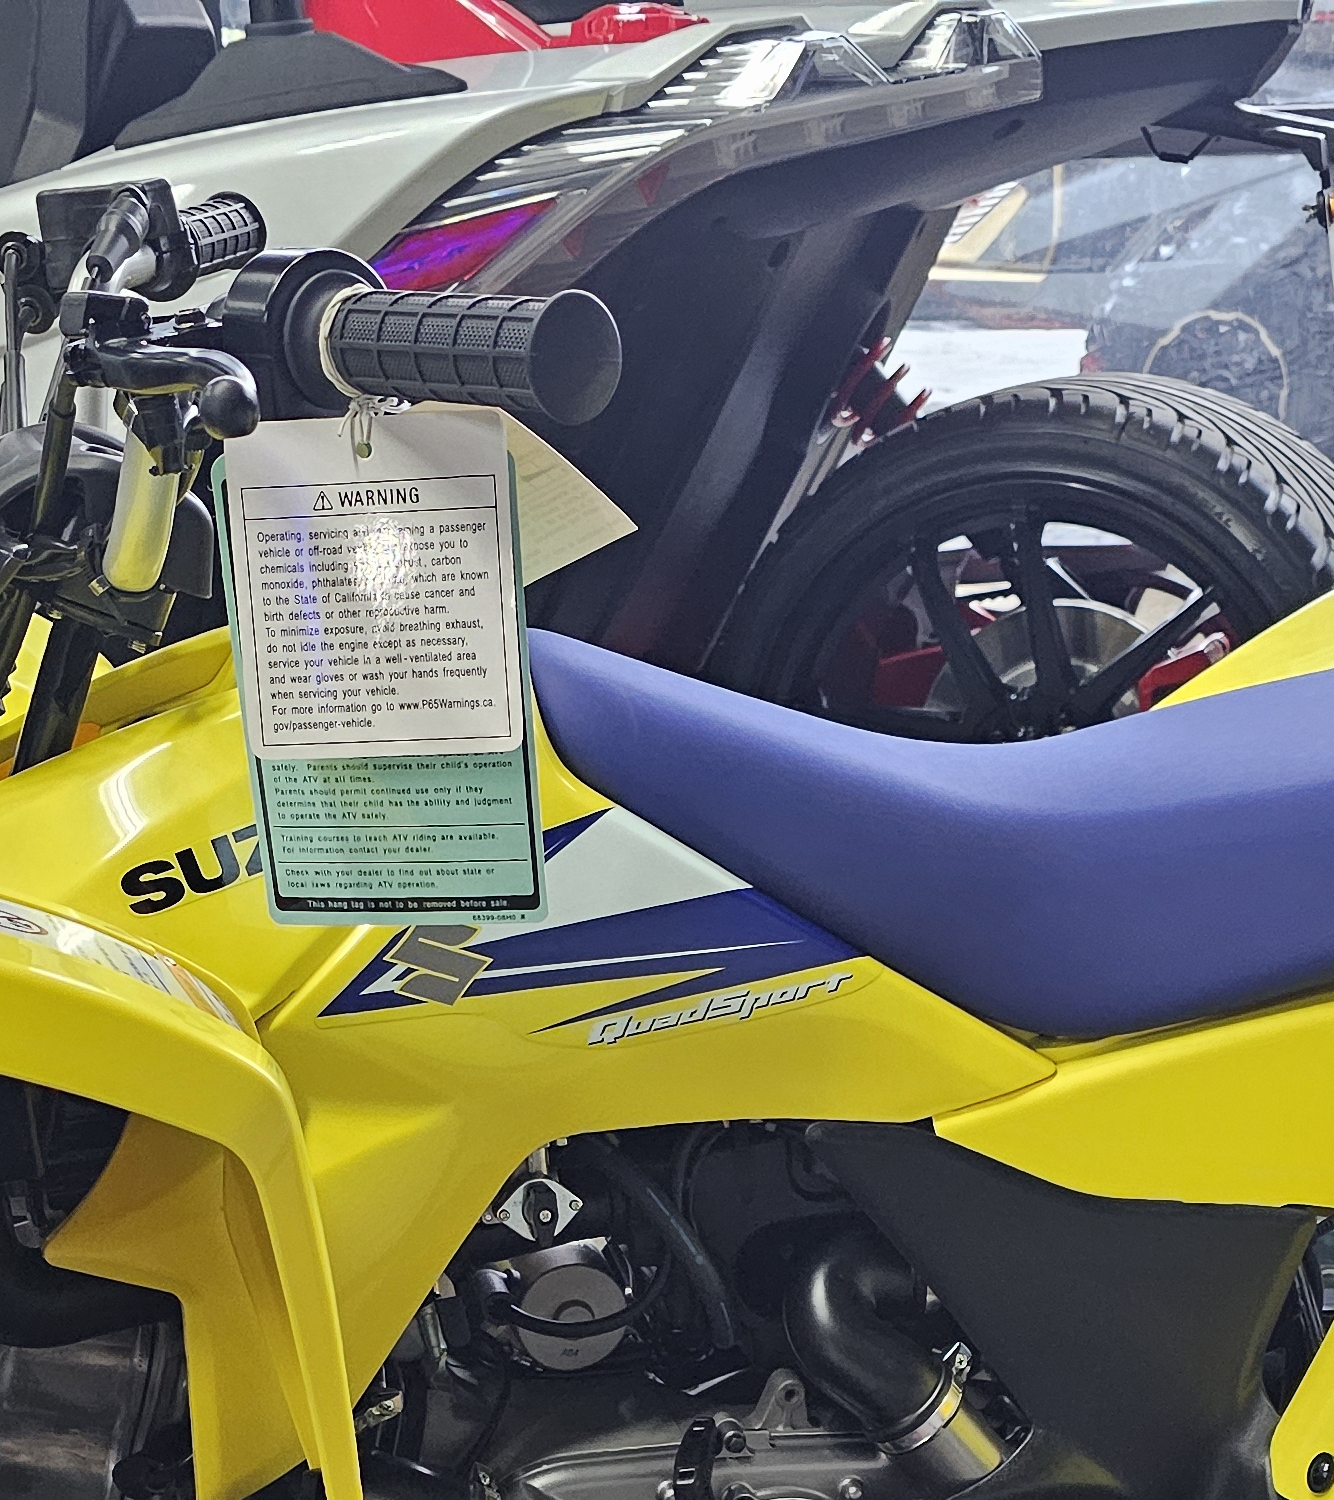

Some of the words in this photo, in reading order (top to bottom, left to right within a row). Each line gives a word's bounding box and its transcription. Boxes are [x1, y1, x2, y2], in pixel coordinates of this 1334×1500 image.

[338, 487, 420, 507] WARNING
[257, 531, 303, 544] Operating,
[309, 528, 348, 540] servicing
[429, 525, 434, 533] a
[439, 523, 485, 535] passenger
[258, 547, 290, 558] vehicle
[294, 548, 303, 557] or
[308, 544, 342, 556] off-road
[439, 541, 454, 552] you
[459, 538, 468, 548] to
[260, 562, 304, 574] chemicals
[309, 558, 349, 572] including
[431, 555, 461, 566] carbon
[261, 578, 307, 590] monoxide,
[411, 572, 436, 583] which
[441, 573, 455, 581] are
[460, 570, 488, 580] known
[262, 597, 271, 606] to
[275, 595, 289, 605] the
[294, 594, 317, 604] State
[321, 592, 330, 603] of
[335, 590, 377, 603] California
[424, 589, 454, 598] cancer
[459, 586, 475, 596] and
[264, 611, 284, 621] birth
[288, 610, 320, 620] defects
[325, 611, 334, 619] or
[338, 608, 360, 618] other
[424, 605, 449, 614] harm.
[265, 627, 275, 637] To
[280, 626, 319, 636] minimize
[324, 626, 367, 636] exposure,
[399, 620, 440, 632] breathing
[445, 619, 483, 629] exhaust,
[266, 643, 277, 653] do
[282, 643, 296, 652] not
[300, 642, 316, 651] idle
[320, 641, 334, 651] the
[339, 640, 368, 652] engine
[373, 638, 401, 650] except
[406, 639, 416, 647] as
[420, 637, 467, 647] necessary,
[268, 658, 299, 668] service
[304, 659, 323, 670] your
[327, 655, 358, 666] vehicle
[363, 654, 371, 664] in
[375, 656, 380, 664] a
[457, 652, 476, 660] area
[269, 674, 285, 684] and
[290, 675, 311, 683] wear
[316, 672, 344, 685] gloves
[348, 673, 357, 681] or
[362, 670, 384, 680] wash
[388, 671, 407, 682] your
[411, 668, 438, 678] hands
[443, 666, 487, 678] frequently
[270, 690, 294, 699] when
[298, 688, 337, 700] servicing
[342, 689, 361, 700] your
[365, 685, 398, 696] vehicle.
[272, 705, 286, 715] For
[291, 706, 313, 714] more
[318, 703, 366, 713] information
[371, 703, 381, 714] go
[386, 702, 394, 711] to
[273, 719, 375, 733] gov/passenger-vehicle.
[272, 763, 297, 772] safely.
[440, 761, 468, 769] child's
[473, 761, 512, 769] operation
[303, 775, 318, 783] ATV
[335, 775, 345, 783] all
[340, 788, 366, 796] permit
[370, 787, 410, 795] continued
[465, 786, 483, 794] they
[327, 900, 347, 909] hang
[351, 901, 363, 909] tag
[588, 972, 853, 1046] QuadSport
